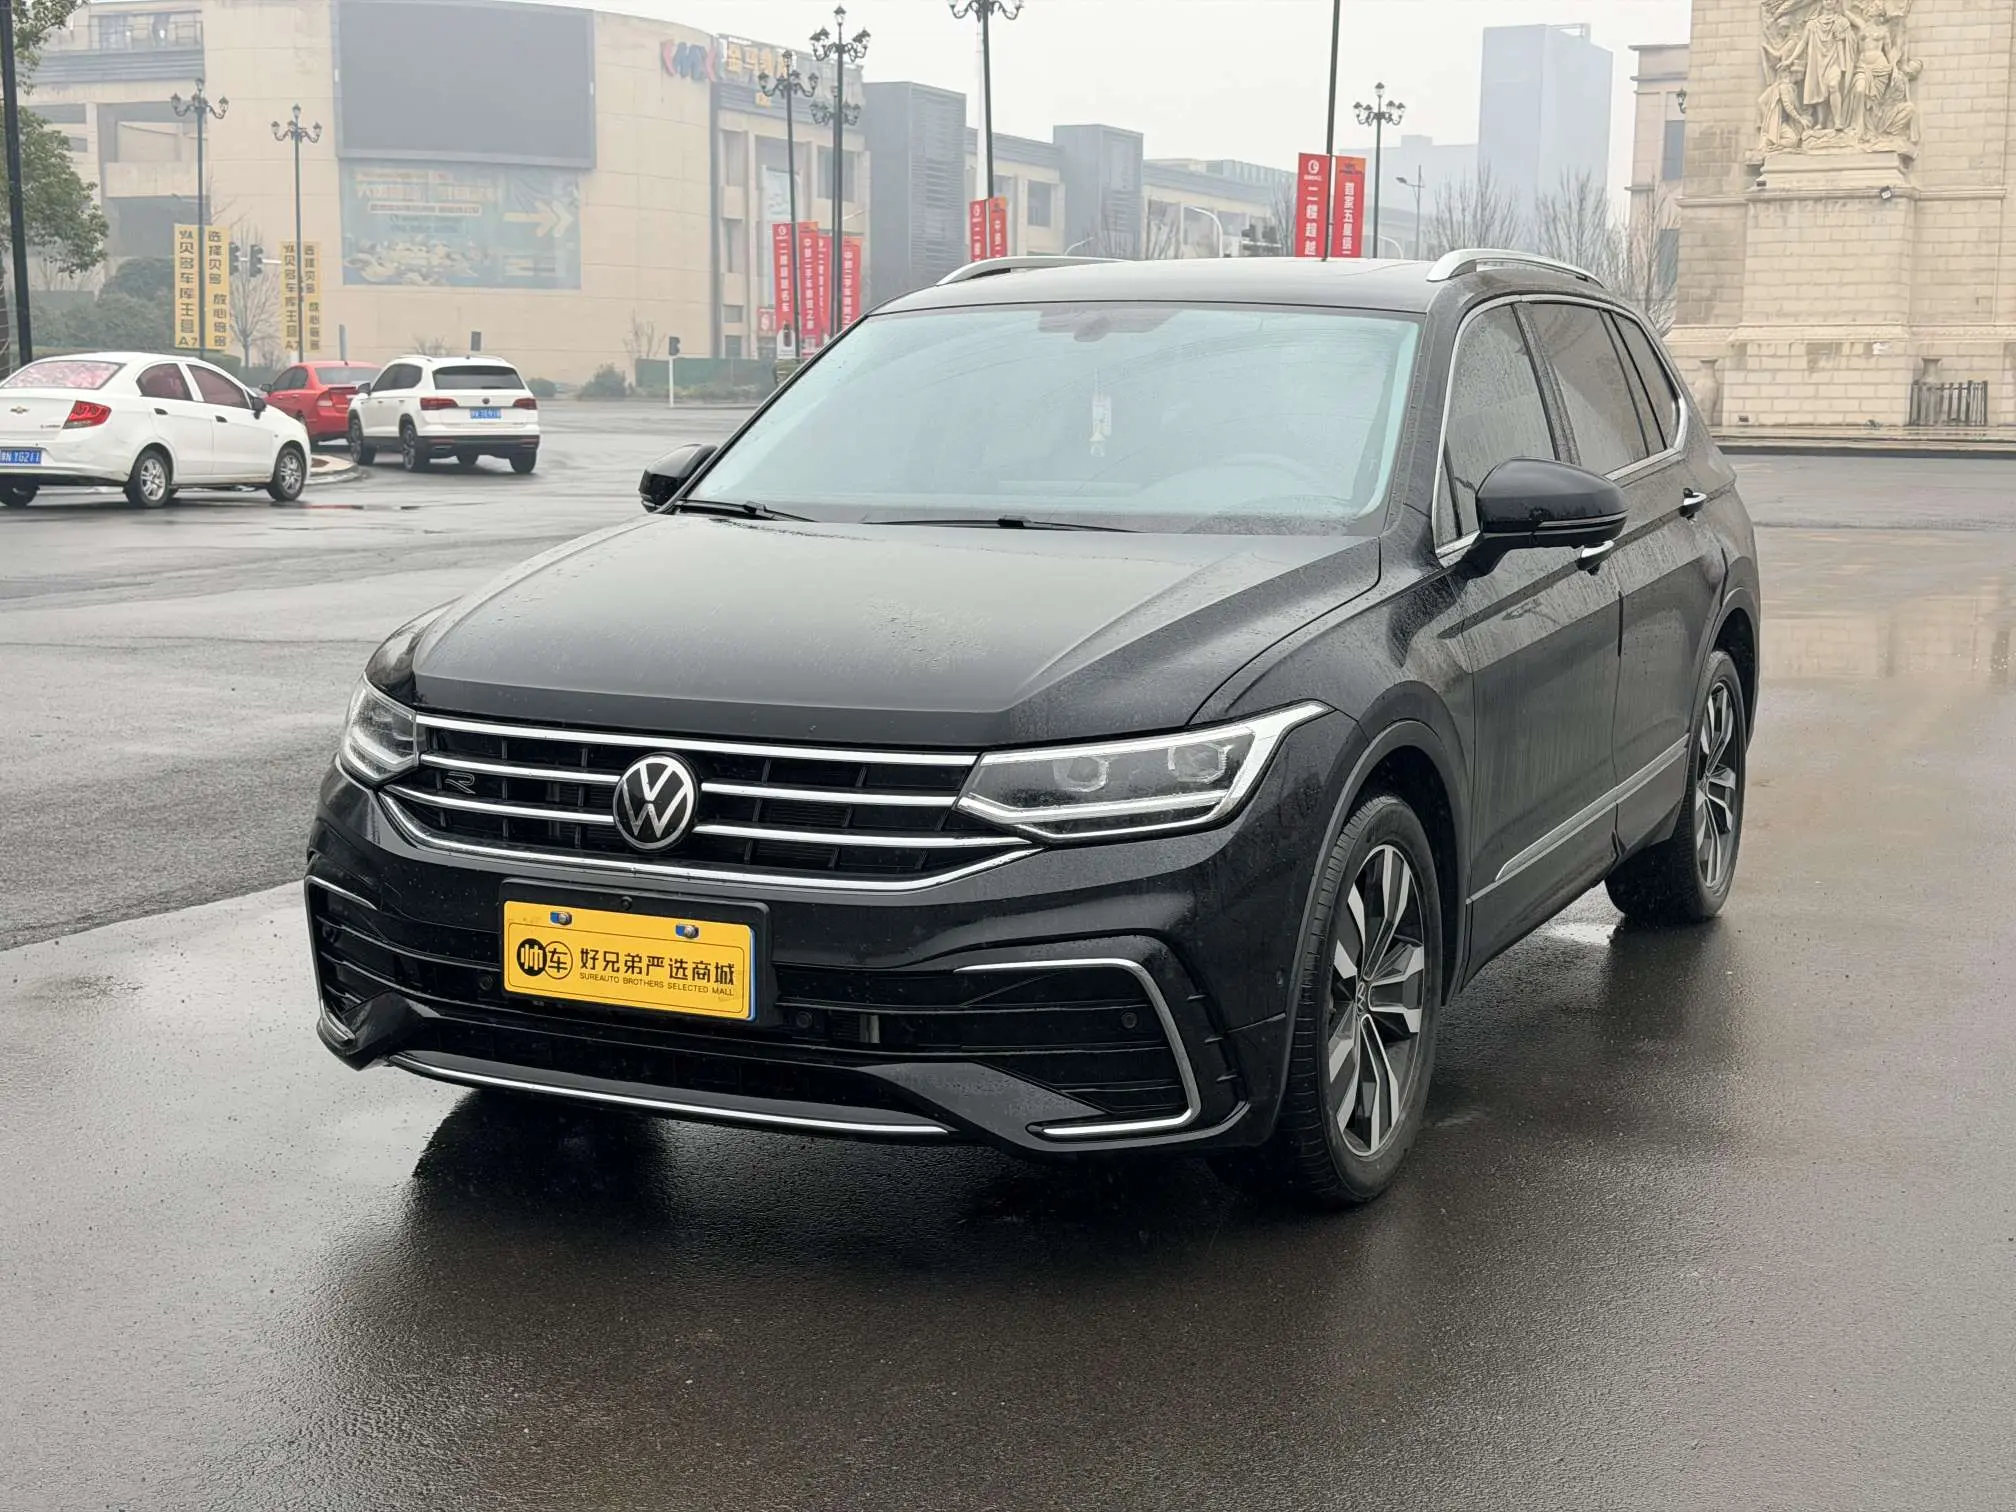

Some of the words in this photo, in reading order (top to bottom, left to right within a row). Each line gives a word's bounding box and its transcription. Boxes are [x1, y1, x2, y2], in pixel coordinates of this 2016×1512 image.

[580, 947, 735, 986] 好兄弟严选商城
[579, 972, 620, 985] SUREAUTO
[623, 977, 664, 989] BROTHERS
[667, 982, 709, 994] SELECTED
[712, 986, 735, 997] MALL
